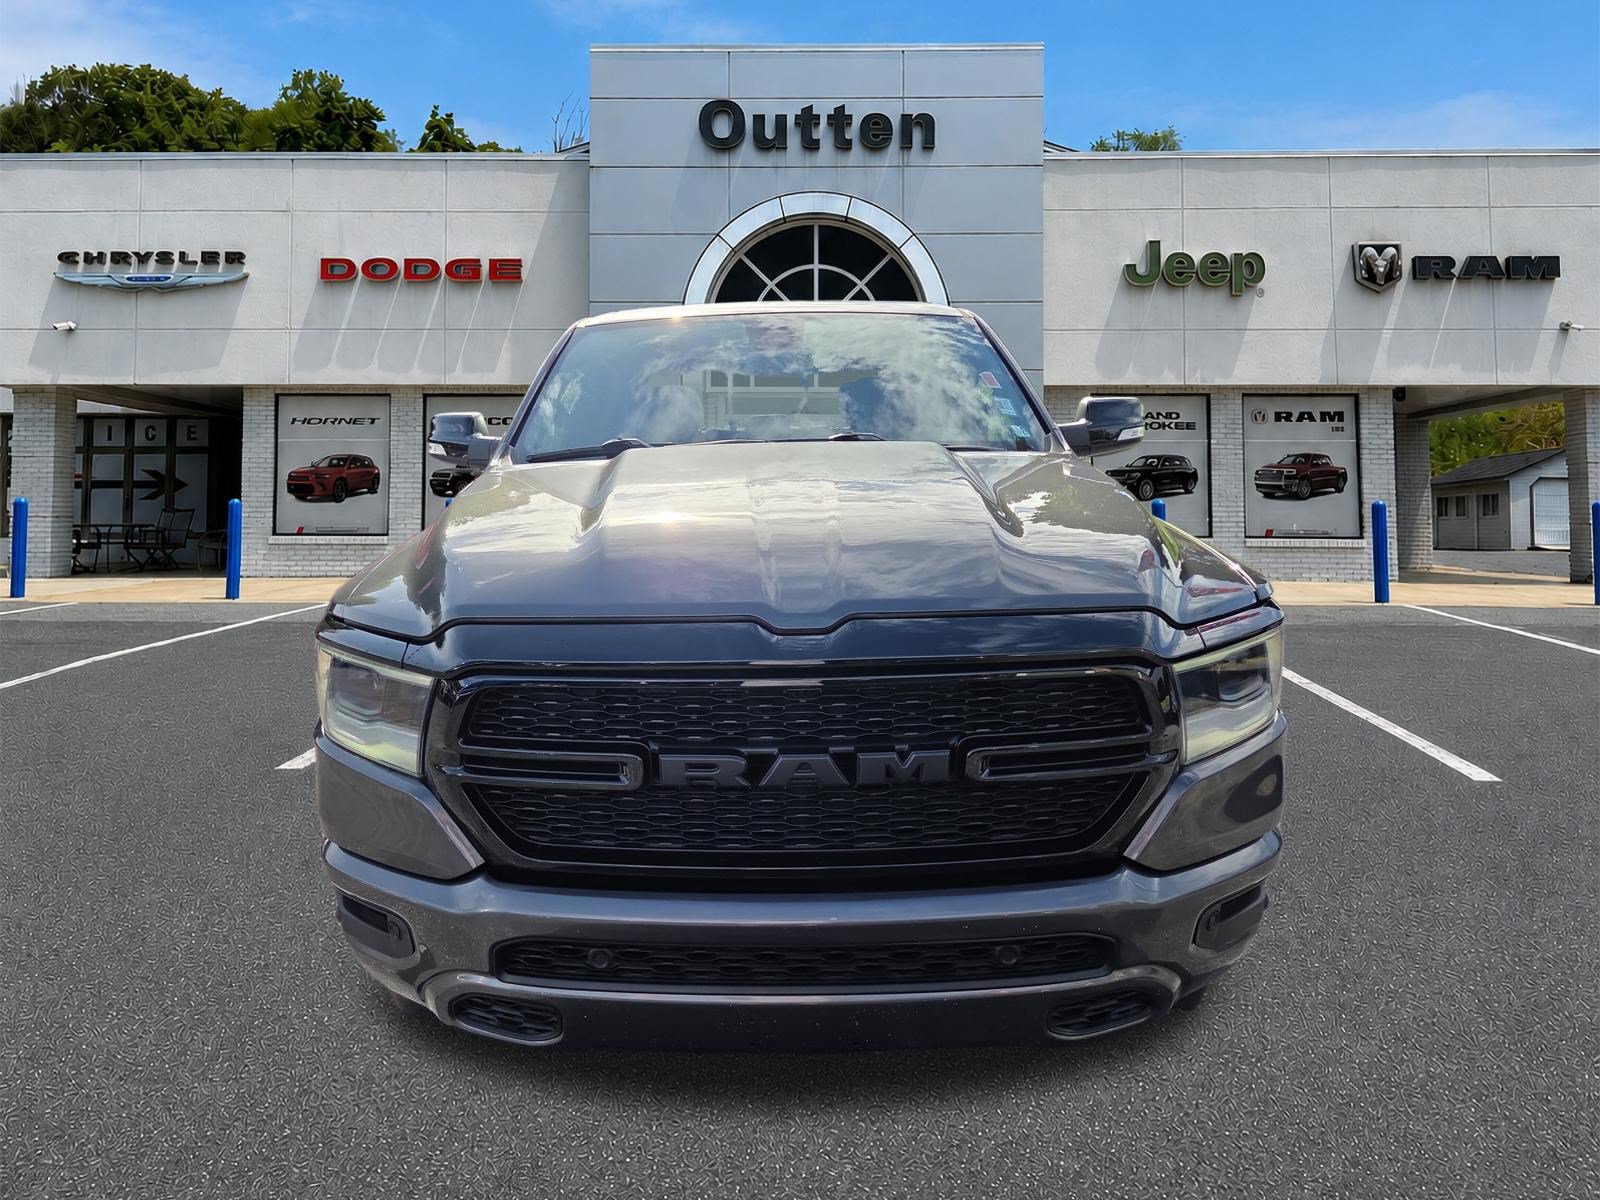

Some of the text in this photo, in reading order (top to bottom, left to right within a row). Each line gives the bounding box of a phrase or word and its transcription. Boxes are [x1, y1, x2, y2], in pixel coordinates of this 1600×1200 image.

[699, 99, 936, 150] Outten
[57, 251, 247, 266] CHRYSLER
[320, 257, 523, 282] DODGE
[1123, 239, 1266, 296] Jeep
[1411, 255, 1561, 280] RAM
[290, 417, 382, 426] HORNET
[1143, 411, 1180, 420] AND
[1274, 411, 1345, 423] RAM
[658, 751, 951, 787] RAM
